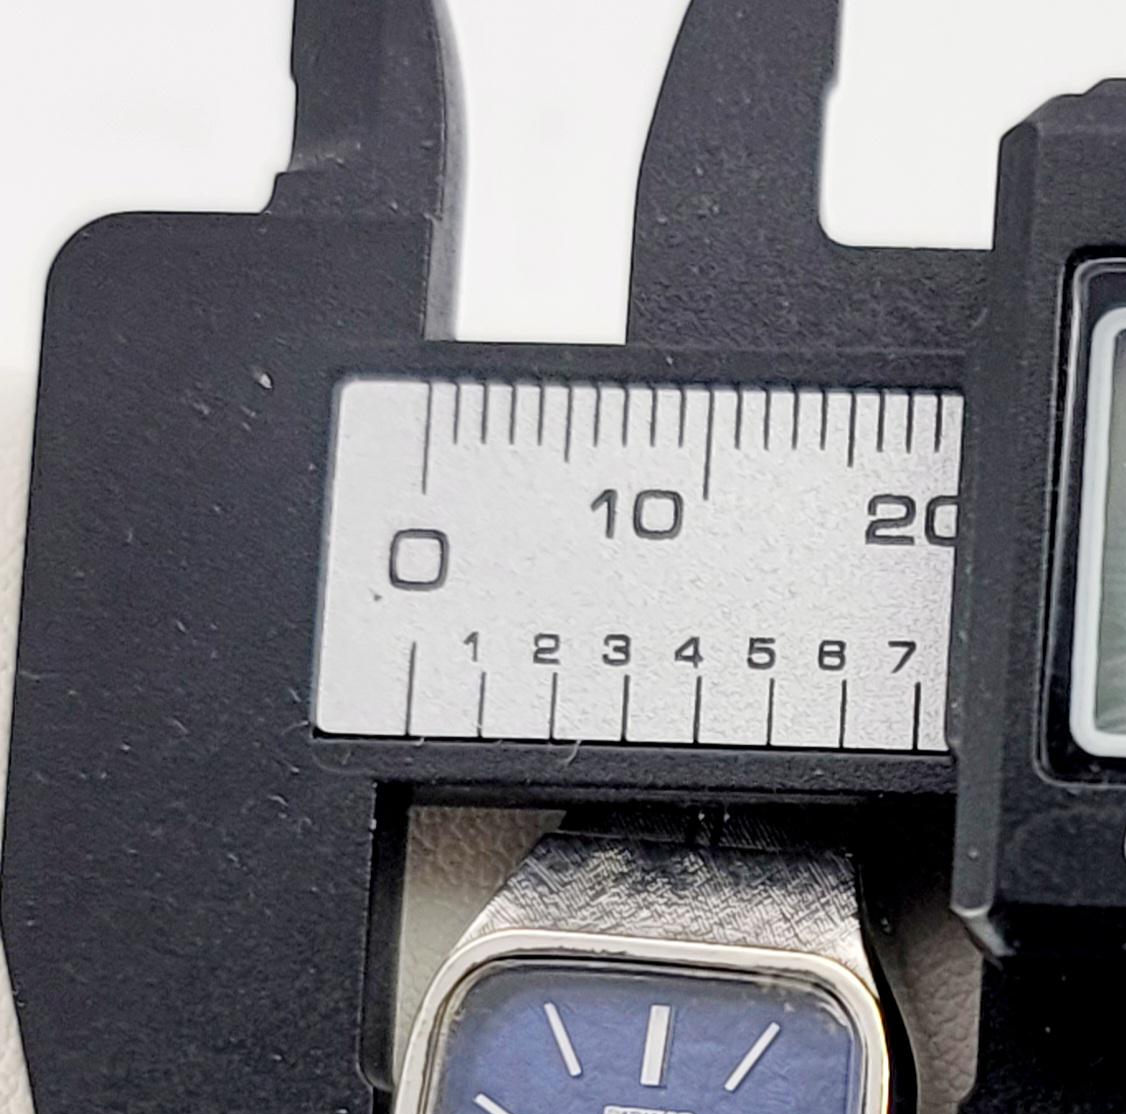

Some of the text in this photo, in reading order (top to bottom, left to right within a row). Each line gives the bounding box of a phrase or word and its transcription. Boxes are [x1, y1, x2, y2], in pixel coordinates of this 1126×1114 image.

[590, 488, 959, 547] 10 20
[388, 527, 449, 592] 0
[463, 631, 917, 674] 1 2 3 4 5 6 7
